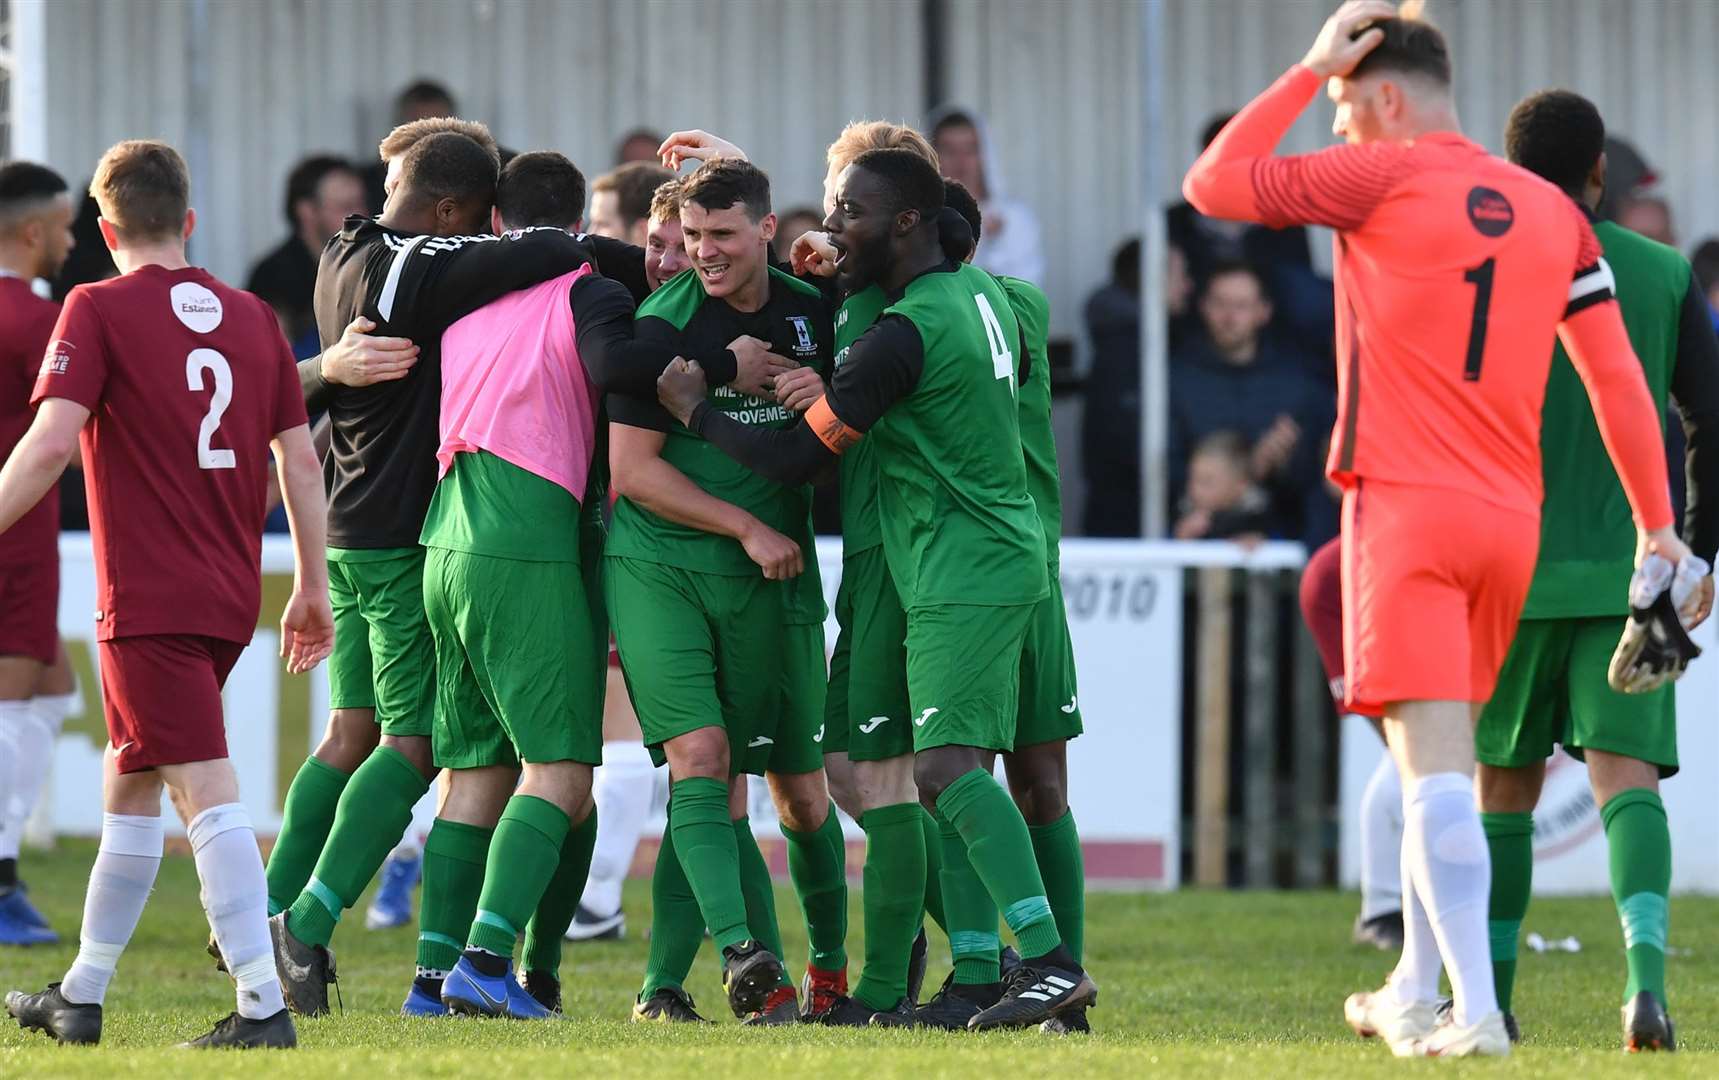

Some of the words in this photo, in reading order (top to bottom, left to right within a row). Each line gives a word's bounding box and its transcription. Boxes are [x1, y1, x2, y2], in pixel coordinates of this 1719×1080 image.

[974, 292, 1014, 381] 4
[1464, 257, 1496, 381] 1
[186, 348, 236, 469] 2
[1063, 575, 1158, 621] 010
